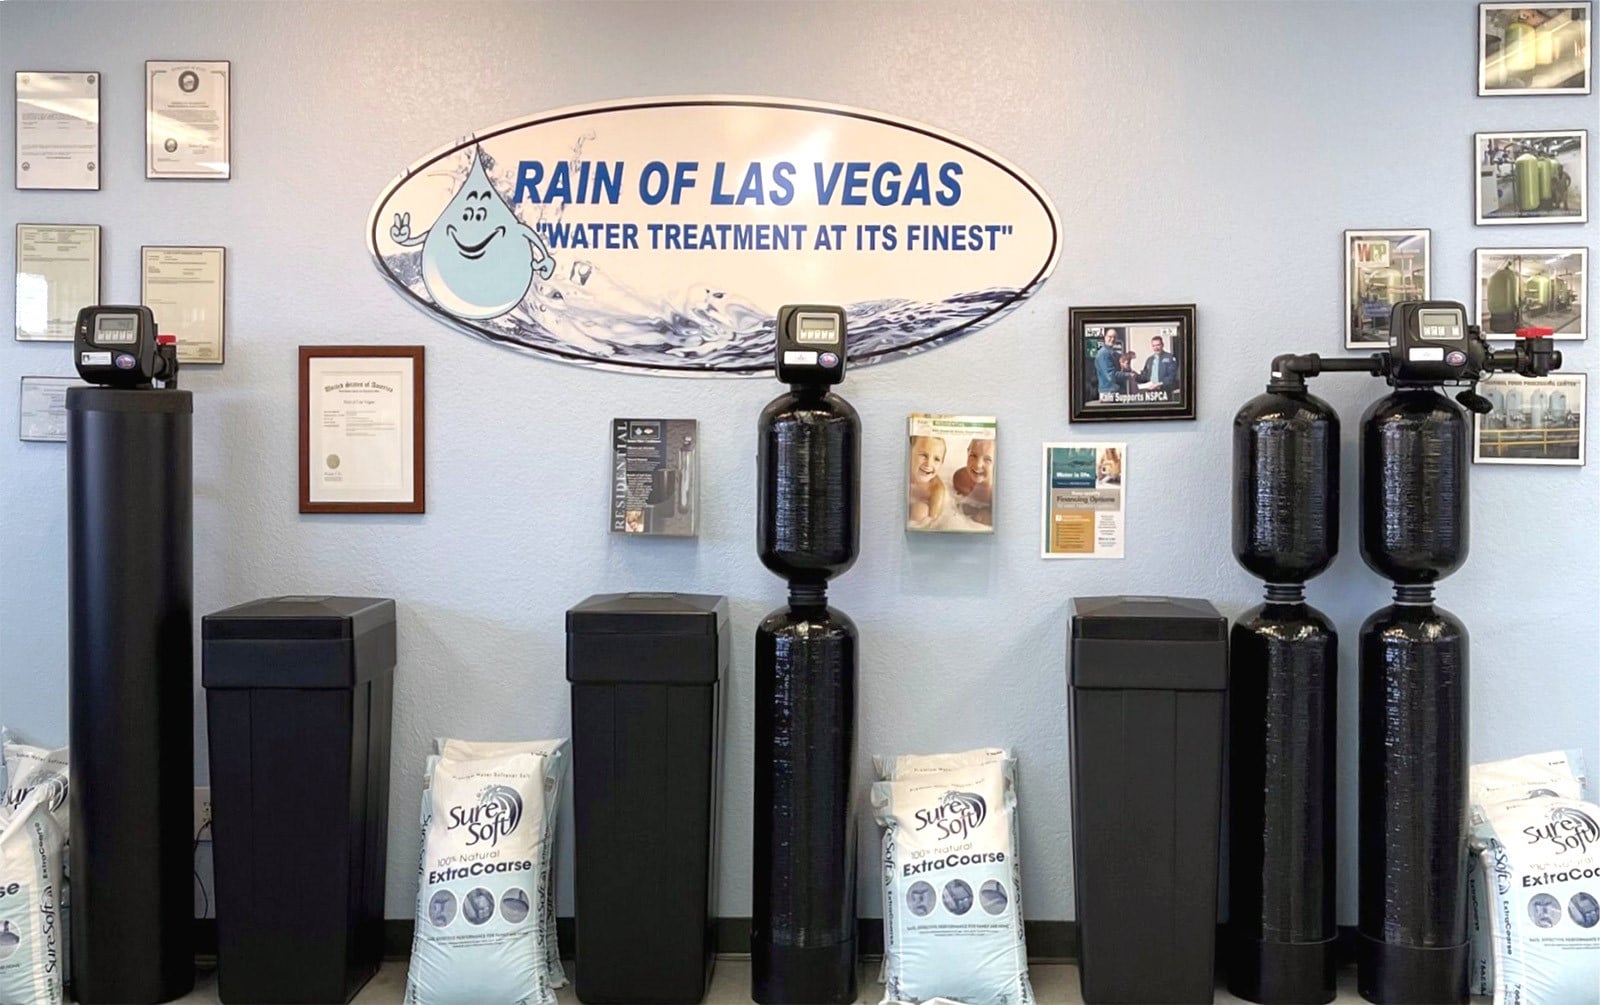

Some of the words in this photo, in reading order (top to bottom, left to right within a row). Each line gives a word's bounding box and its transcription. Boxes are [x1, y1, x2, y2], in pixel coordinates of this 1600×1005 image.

[514, 160, 625, 204] RAIN
[638, 160, 699, 206] OF
[710, 161, 797, 206] LAS
[813, 161, 964, 207] VEGAS
[535, 222, 639, 250] "WATER
[647, 223, 807, 250] TREATMENT
[813, 224, 847, 250] AT
[856, 225, 897, 251] ITS
[906, 225, 1014, 251] FINEST"
[1115, 392, 1144, 404] Supports
[1145, 391, 1169, 401] NSPCA
[614, 420, 628, 530] RESIDENTIAL
[447, 802, 499, 830] Sure
[465, 810, 511, 848] Soft
[915, 800, 962, 831] Sure
[937, 808, 977, 840] Soft
[1523, 819, 1575, 844] Sure
[1551, 824, 1595, 855] Soft
[459, 850, 501, 863] Natural
[934, 842, 973, 855] Natural
[429, 860, 532, 885] ExtraCoarse
[903, 851, 1005, 877] ExtraCoarse
